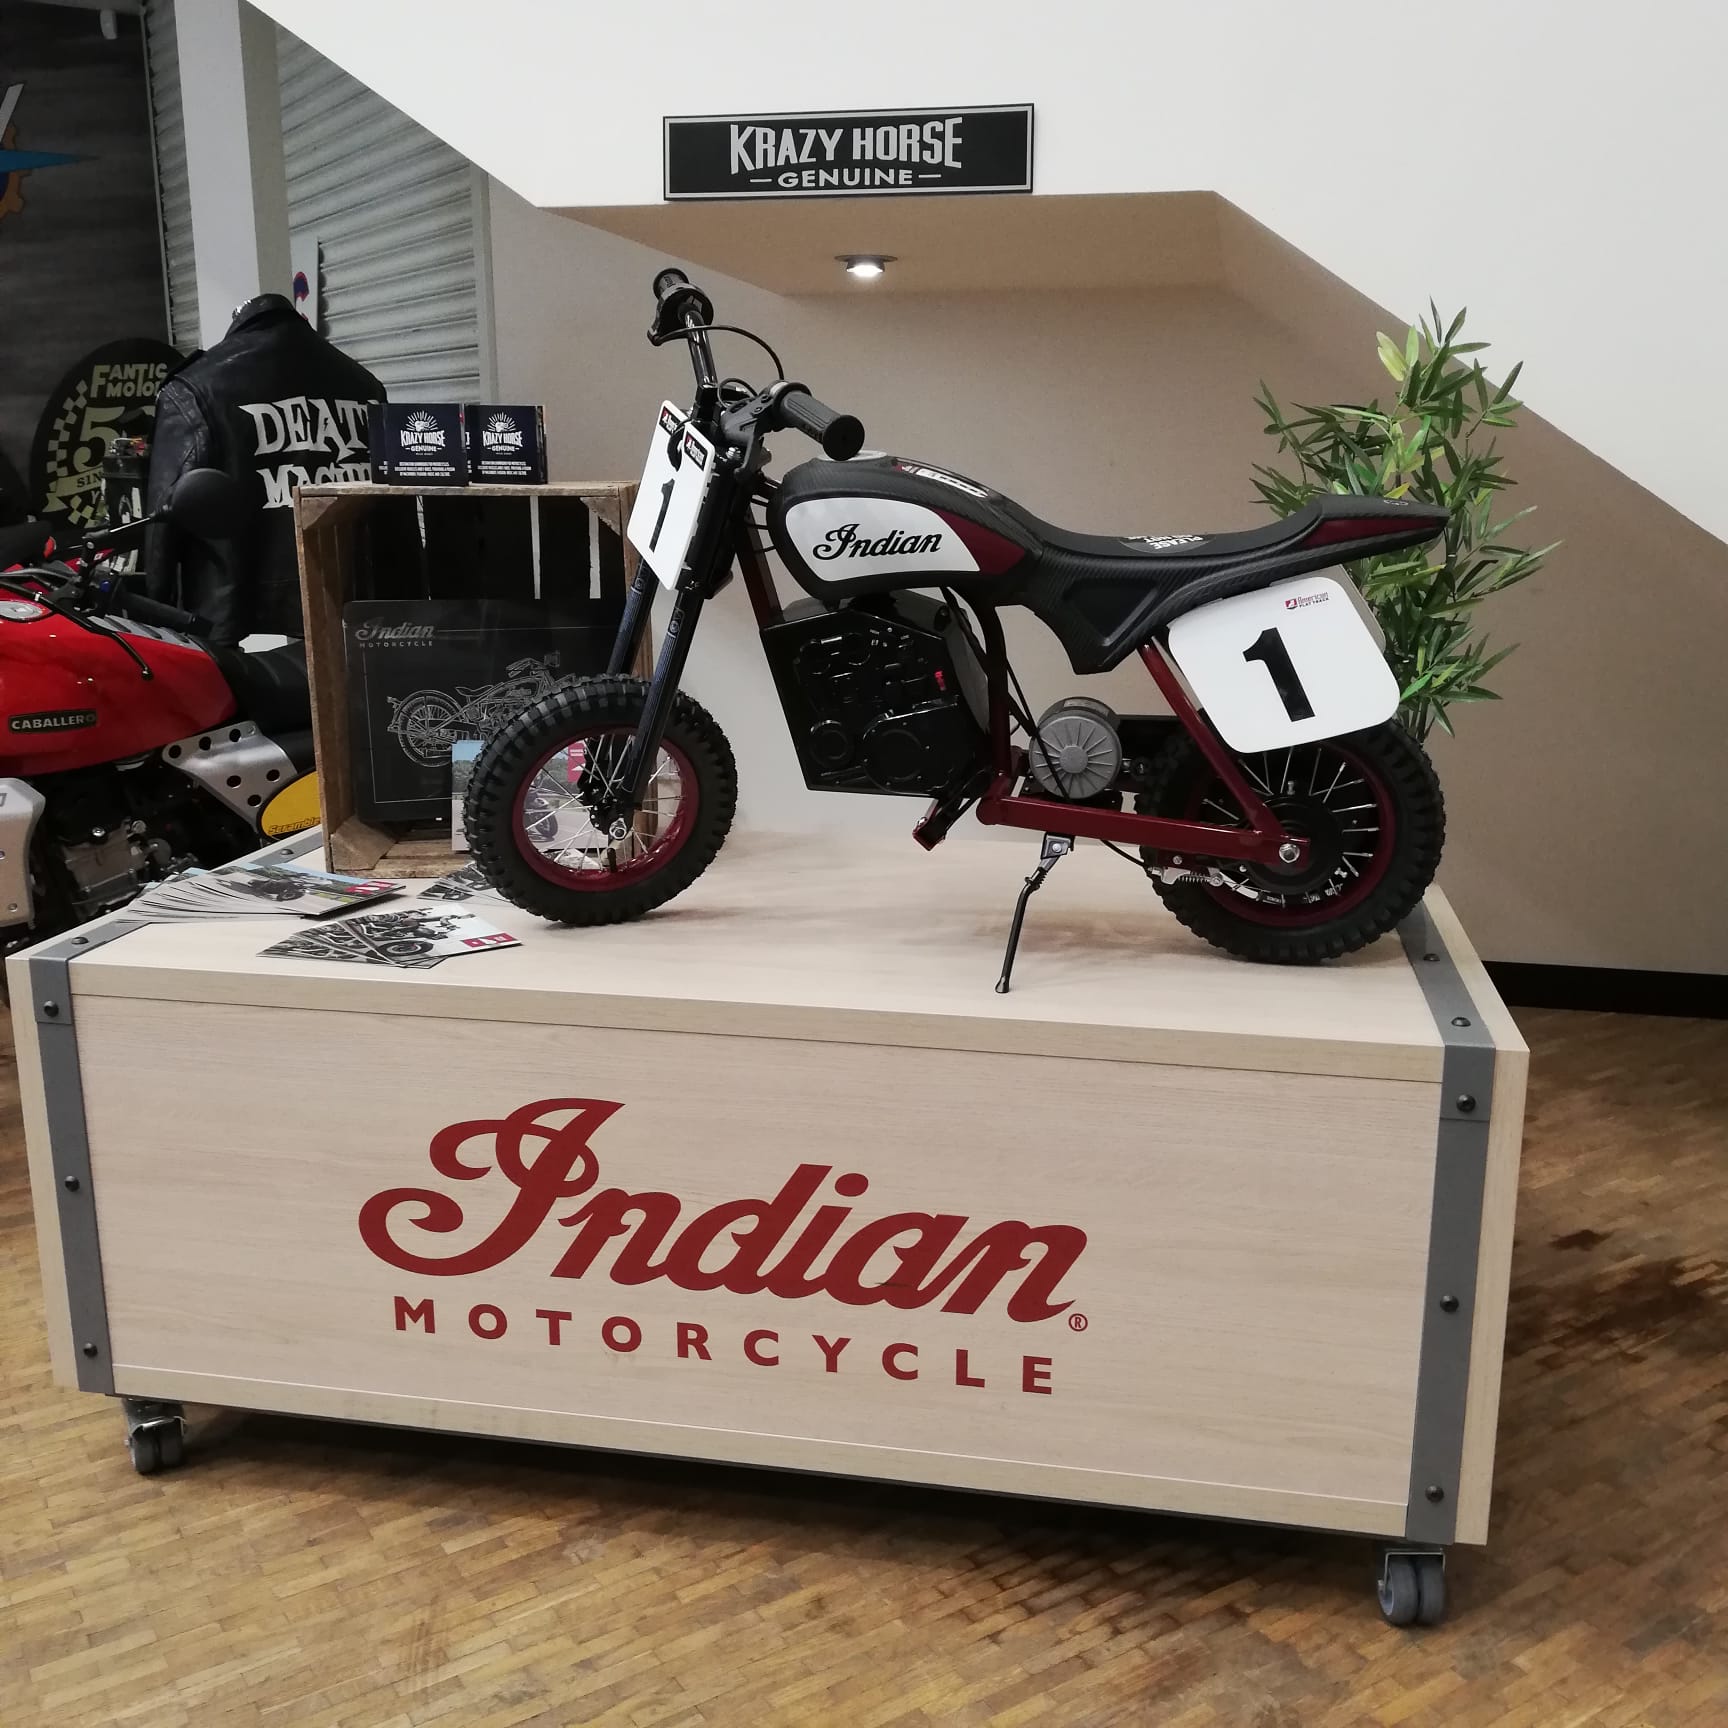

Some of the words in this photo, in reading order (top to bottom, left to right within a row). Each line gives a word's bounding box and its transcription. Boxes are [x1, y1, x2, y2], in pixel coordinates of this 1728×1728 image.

[731, 124, 843, 175] KRAZY
[853, 117, 963, 168] HORSE
[778, 167, 913, 187] GENUINE
[238, 396, 379, 462] DEAT
[400, 430, 423, 447] KRAZY
[424, 430, 446, 447] HORSE
[482, 431, 503, 447] KRAZY
[503, 431, 523, 447] HORSE
[812, 523, 943, 561] Indian
[355, 617, 434, 640] Indian
[1243, 627, 1315, 722] 1
[11, 714, 97, 730] CABALLERO
[359, 1097, 1087, 1323] Indian
[394, 1296, 1053, 1394] MOTORCYCLE
